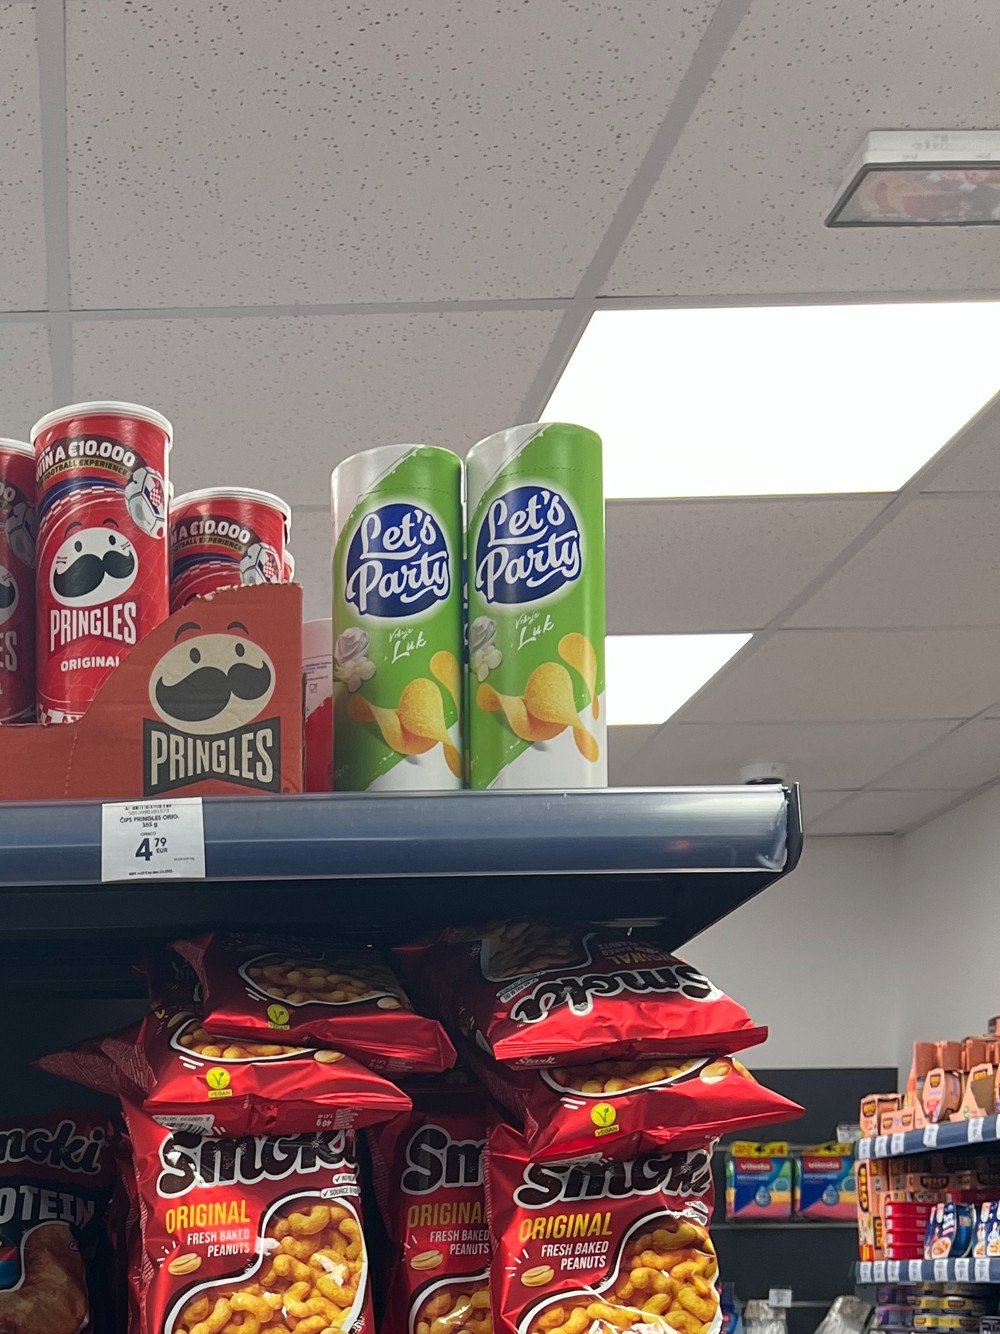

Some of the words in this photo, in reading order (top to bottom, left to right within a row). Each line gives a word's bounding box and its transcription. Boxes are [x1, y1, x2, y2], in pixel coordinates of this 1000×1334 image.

[69, 440, 136, 468] €10.000
[78, 457, 128, 477] EXPERIENCE
[488, 489, 566, 548] Let's
[190, 519, 251, 544] €10.000
[360, 509, 436, 560] Let's
[475, 530, 581, 602] Party
[345, 549, 450, 614] Party
[50, 601, 137, 652] PRINGLES
[150, 728, 274, 786] PRINGLES
[135, 838, 153, 861] 4
[154, 837, 167, 847] 79
[596, 1125, 619, 1136] VEGAN
[166, 1199, 251, 1235] ORIGINAL
[519, 1211, 613, 1241] ORIGINAL
[187, 1231, 217, 1246] FRESH
[219, 1228, 250, 1242] BAKED
[430, 1230, 460, 1243] FRESH
[461, 1228, 490, 1242] BAKED
[207, 1242, 250, 1257] PEANUTS
[449, 1242, 490, 1256] PEANUTS
[541, 1243, 572, 1258] FRESH
[573, 1240, 608, 1256] BAKED
[560, 1255, 606, 1271] PEANUTS
